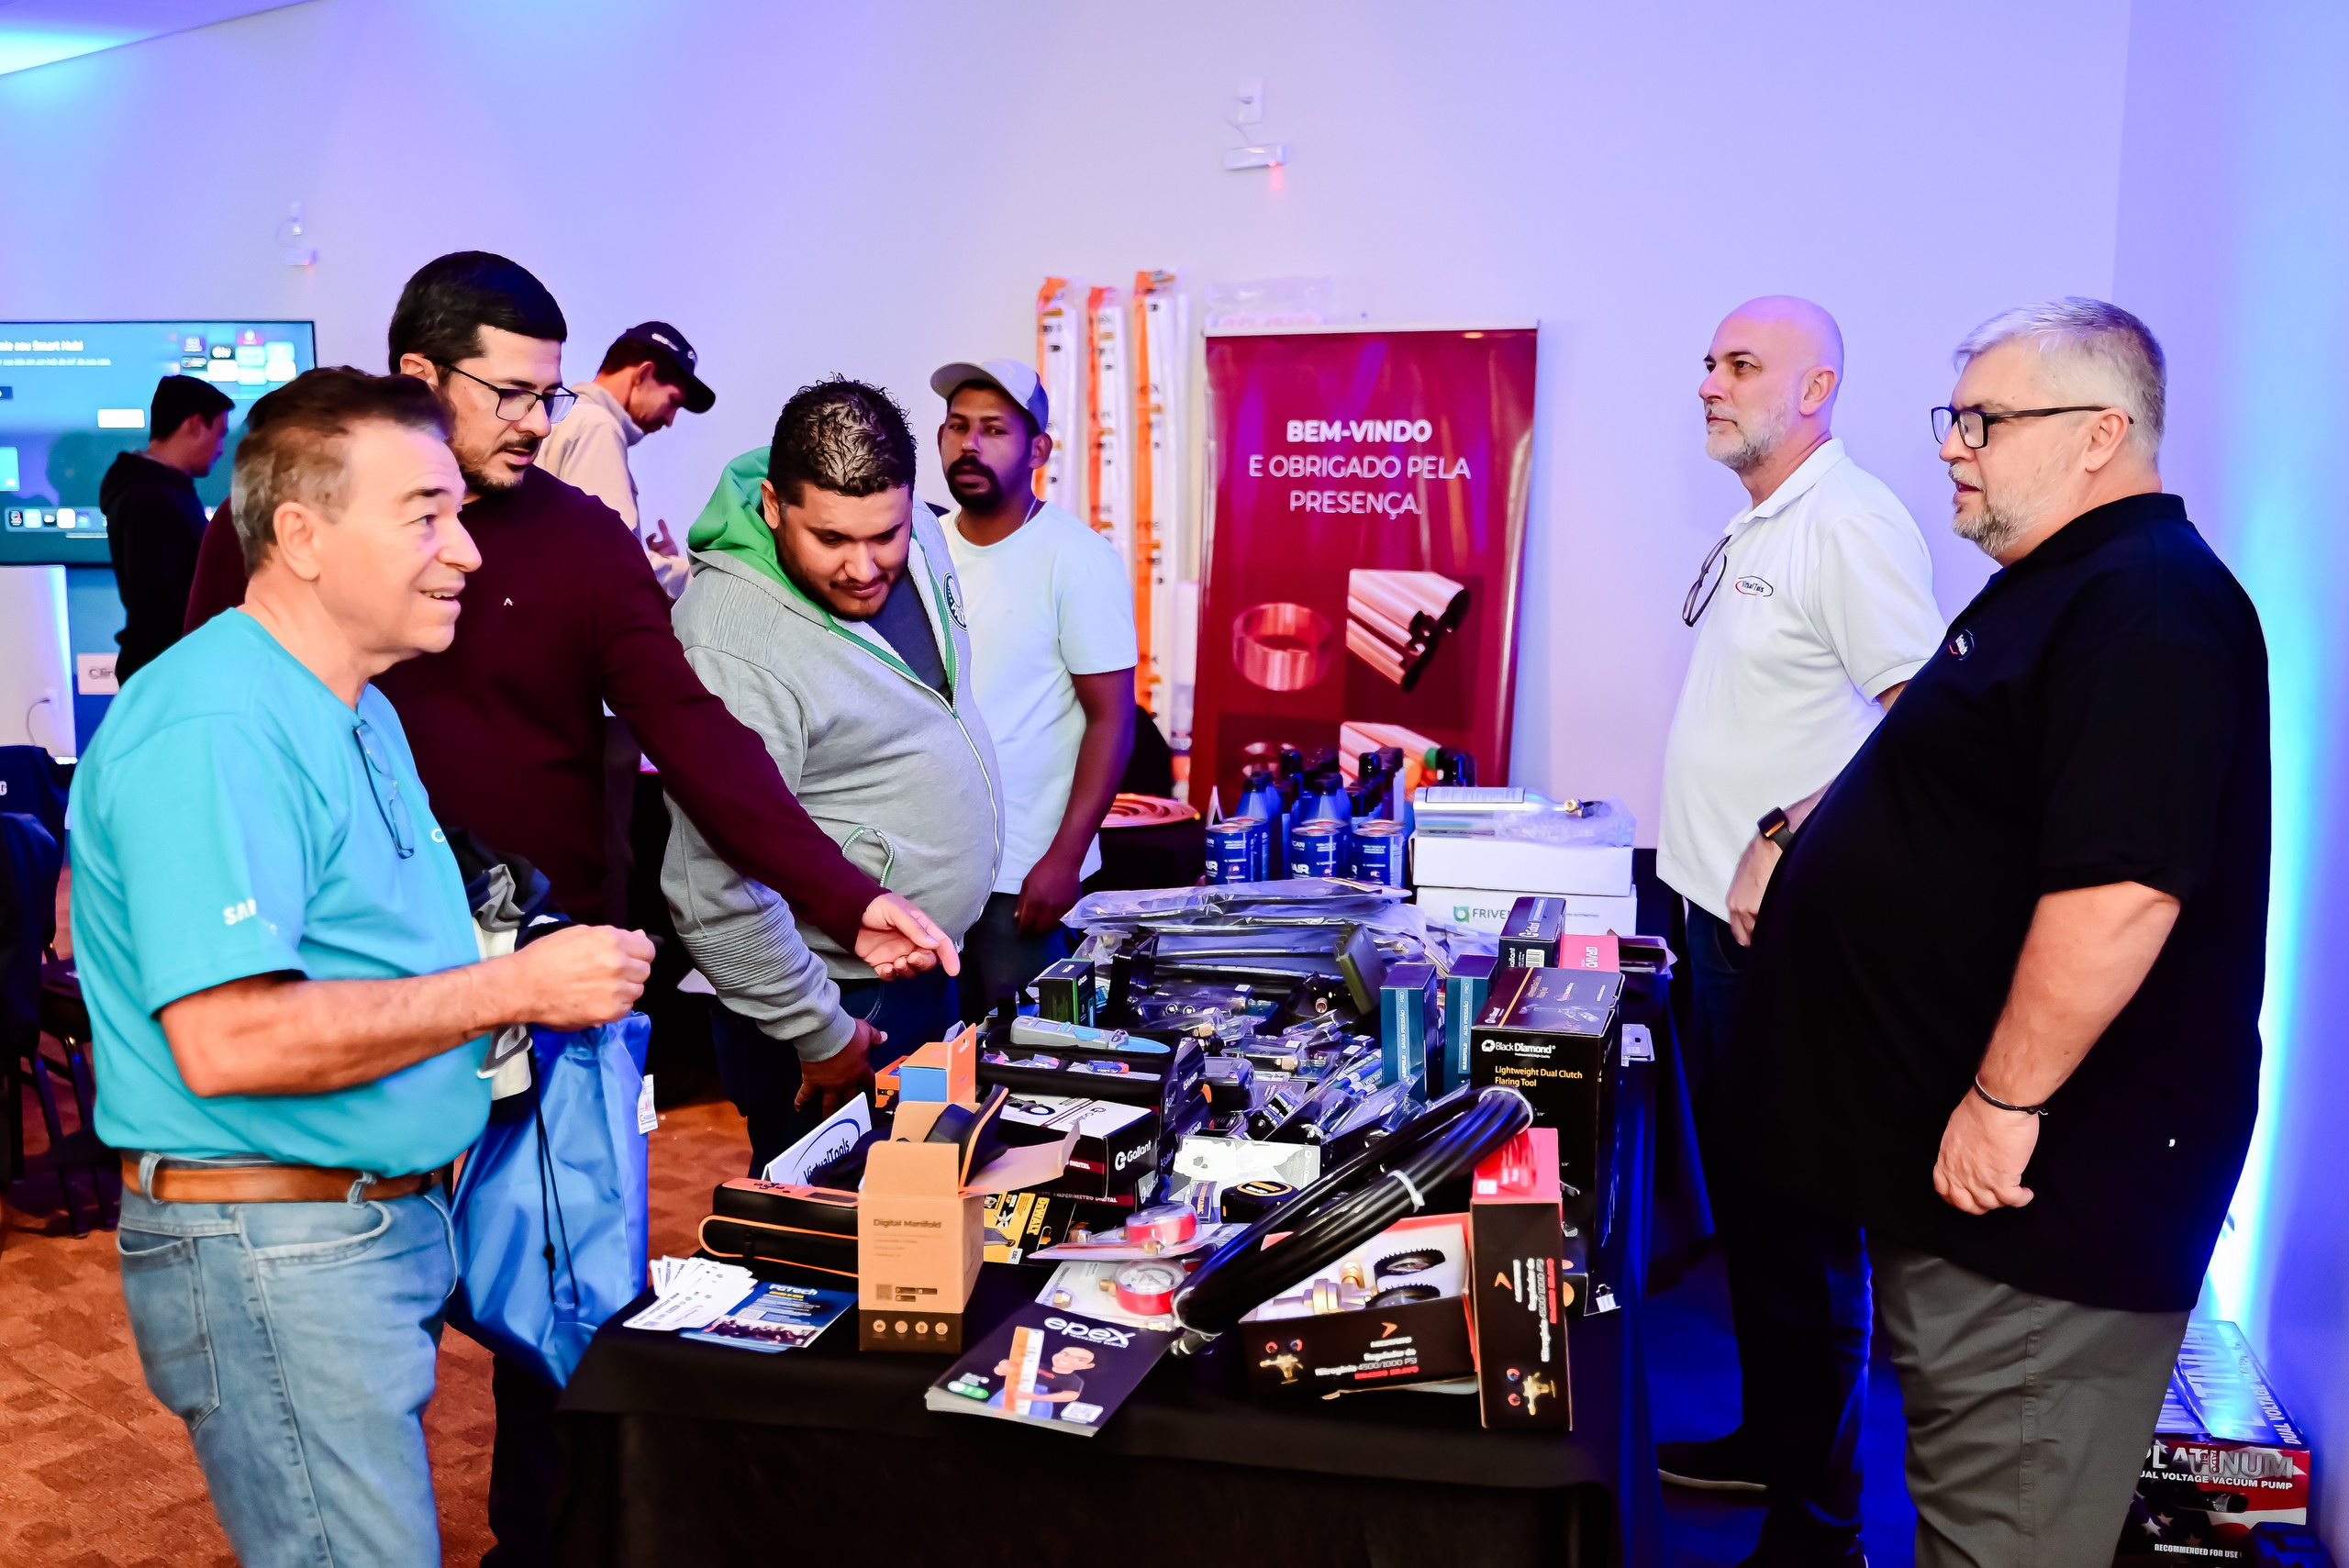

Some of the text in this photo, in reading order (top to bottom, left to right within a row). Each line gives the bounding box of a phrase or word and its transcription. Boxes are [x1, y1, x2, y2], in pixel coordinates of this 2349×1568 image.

[1286, 419, 1432, 443] BEM-VINDO
[1249, 454, 1472, 479] E OBRIGADO PELA
[1472, 908, 1510, 919] FRIVE
[1495, 1065, 1583, 1079] Lightweight Dual Clutch
[1495, 1076, 1537, 1087] Flaring Tool
[1127, 1140, 1152, 1162] Gallant
[874, 1219, 941, 1229] Digital Manifold
[1044, 1317, 1136, 1348] epex
[1358, 1359, 1404, 1371] 4500/1000
[2146, 1445, 2294, 1480] LATINUM
[2141, 1471, 2293, 1490] UAL VOLTAGE VACUUM PUMP
[2154, 1543, 2238, 1559] RECOMMENDED FOR USE
